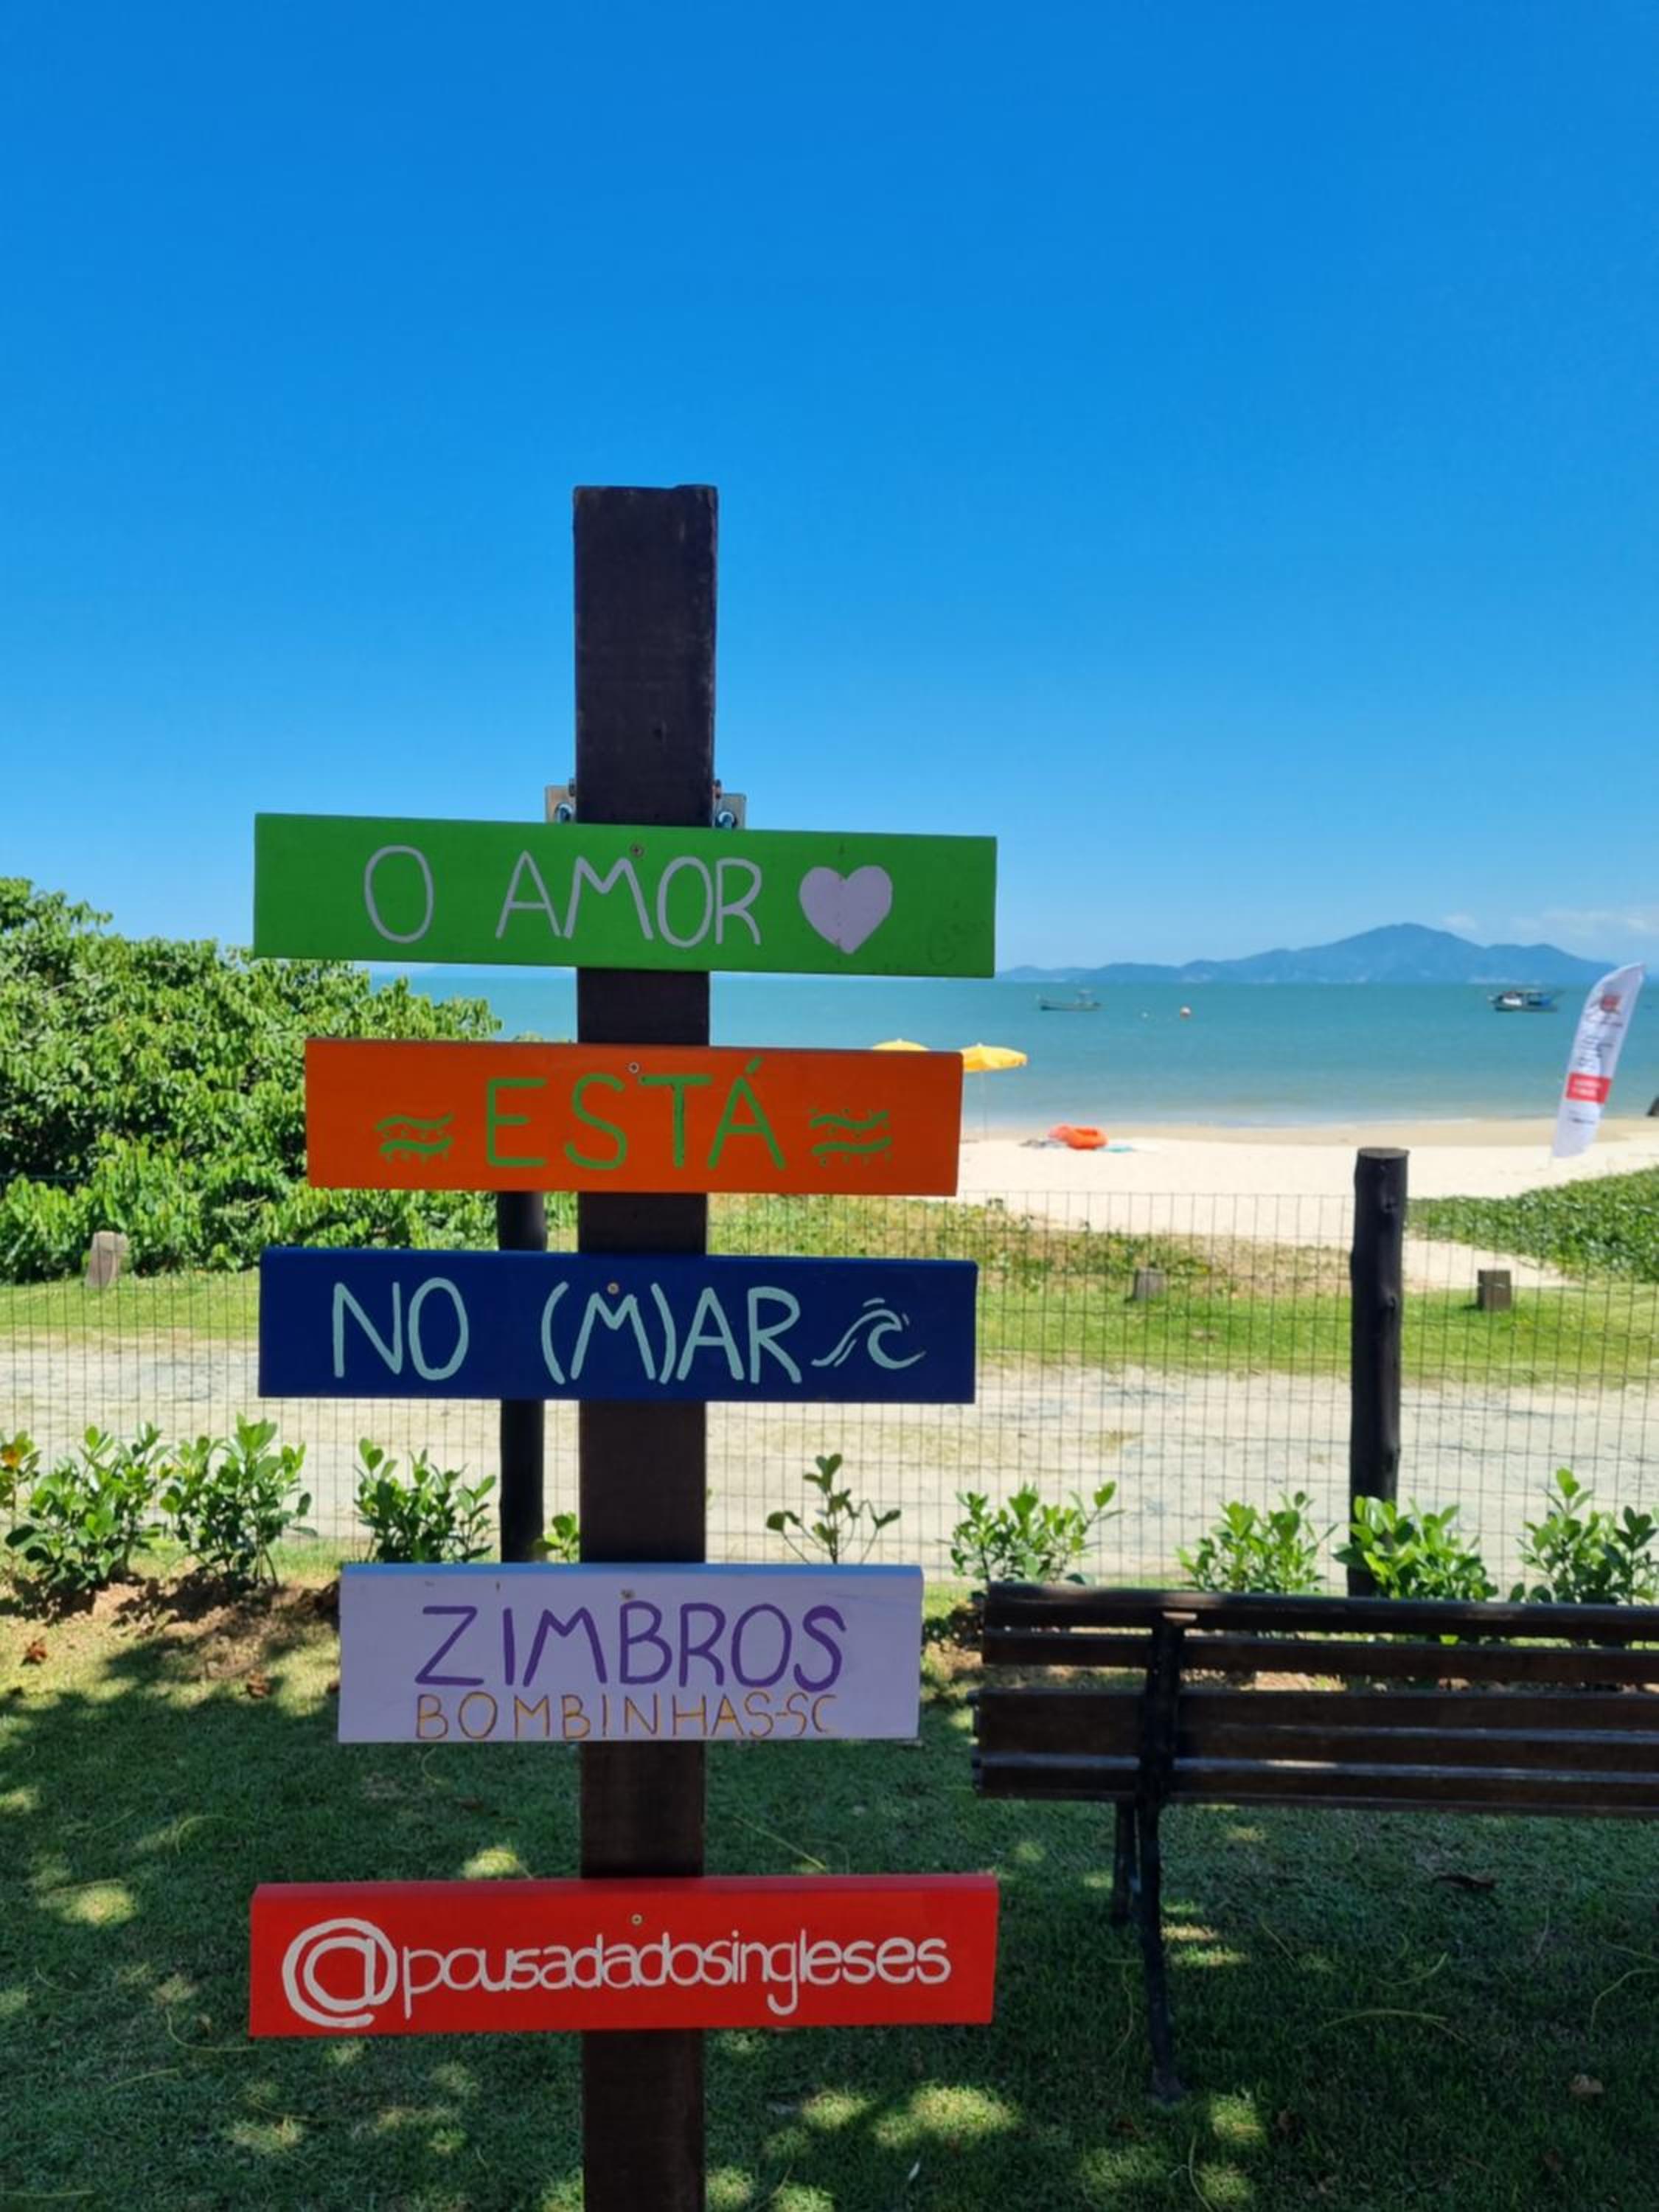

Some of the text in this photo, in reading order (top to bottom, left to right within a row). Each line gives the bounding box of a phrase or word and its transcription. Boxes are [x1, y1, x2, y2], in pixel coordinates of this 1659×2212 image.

[364, 845, 762, 947] O AMOR
[485, 1057, 786, 1171] ESTÁ
[333, 1277, 802, 1385] NO (M)AR
[414, 1601, 847, 1692] ZIMBROS
[282, 1917, 951, 2028] @pousadadosingleses
